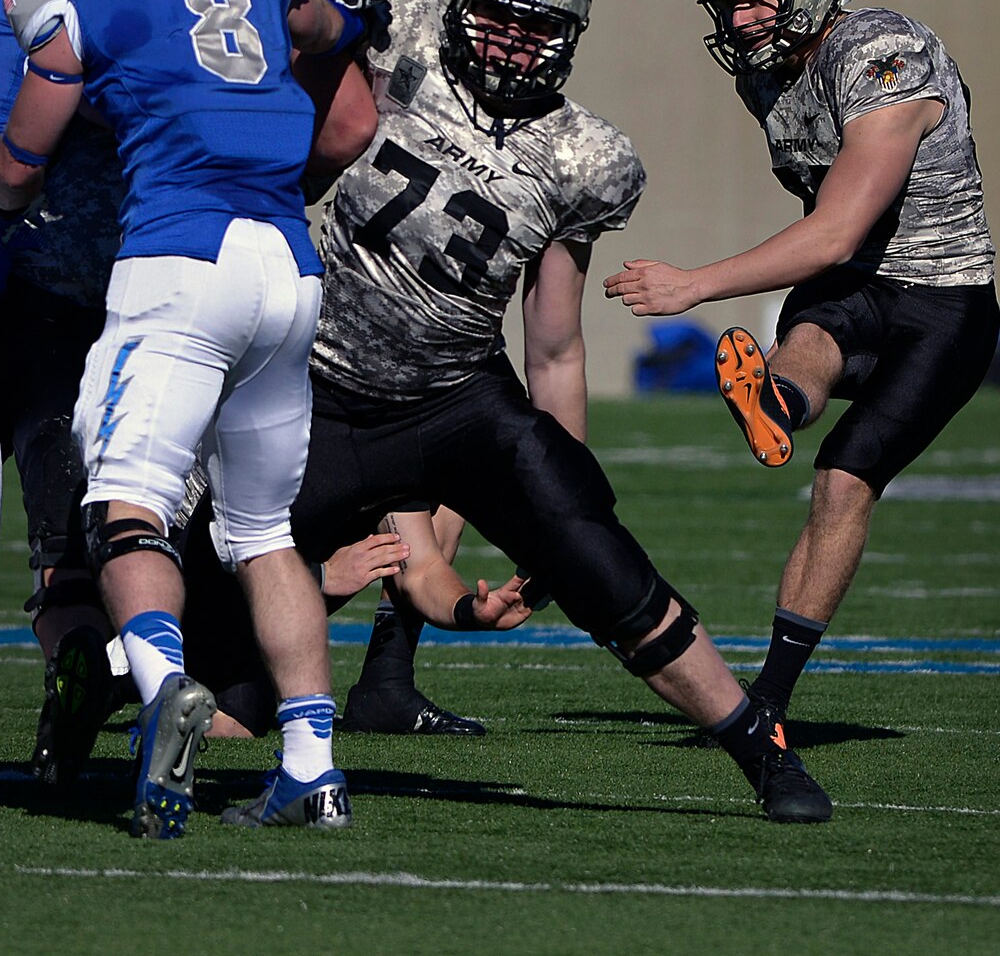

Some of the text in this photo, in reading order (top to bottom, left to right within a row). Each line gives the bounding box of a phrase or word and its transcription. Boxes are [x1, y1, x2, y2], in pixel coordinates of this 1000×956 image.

[424, 135, 504, 184] ARMY
[775, 139, 822, 152] ARMY
[352, 138, 510, 294] 73
